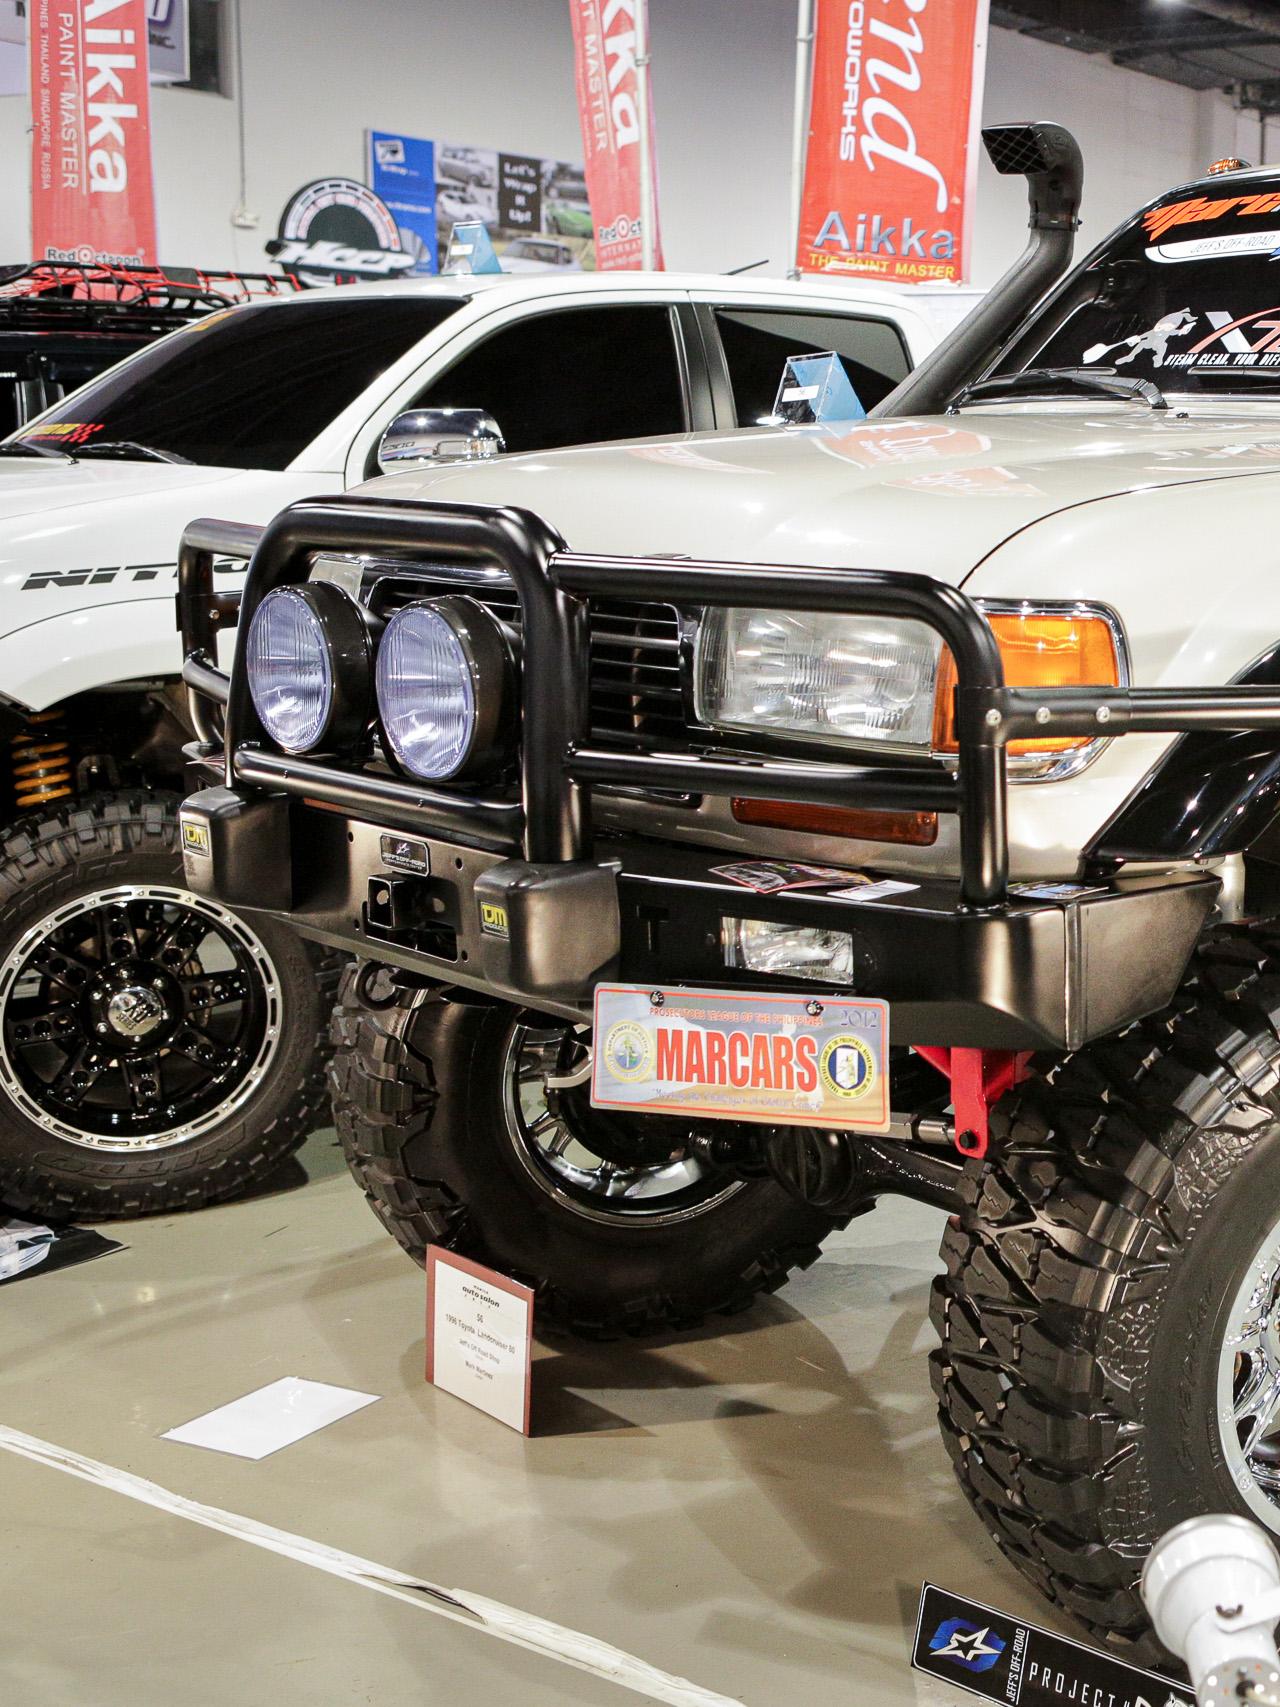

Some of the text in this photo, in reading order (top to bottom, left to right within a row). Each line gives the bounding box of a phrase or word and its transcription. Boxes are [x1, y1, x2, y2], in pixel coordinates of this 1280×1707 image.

[58, 12, 79, 189] PAINT MASTER
[585, 34, 609, 152] MASTER
[840, 0, 865, 161] OWORKS
[813, 211, 955, 260] Aikka
[1222, 233, 1275, 250] OFF-ROAD
[809, 253, 842, 267] THE
[895, 263, 955, 279] MASTER
[1164, 353, 1199, 366] STEAM
[707, 1009, 739, 1022] LEAGUE
[742, 1011, 752, 1023] OF
[756, 1012, 771, 1024] THE
[773, 1013, 824, 1028] PHILIPPINES
[840, 1009, 877, 1028] 2012
[656, 1027, 818, 1093] MARCARS
[462, 1286, 479, 1298] auto
[480, 1293, 500, 1308] salon
[1006, 1628, 1026, 1702] JEFF'S OFF-ROAD
[1029, 1662, 1115, 1707] PROJECT
